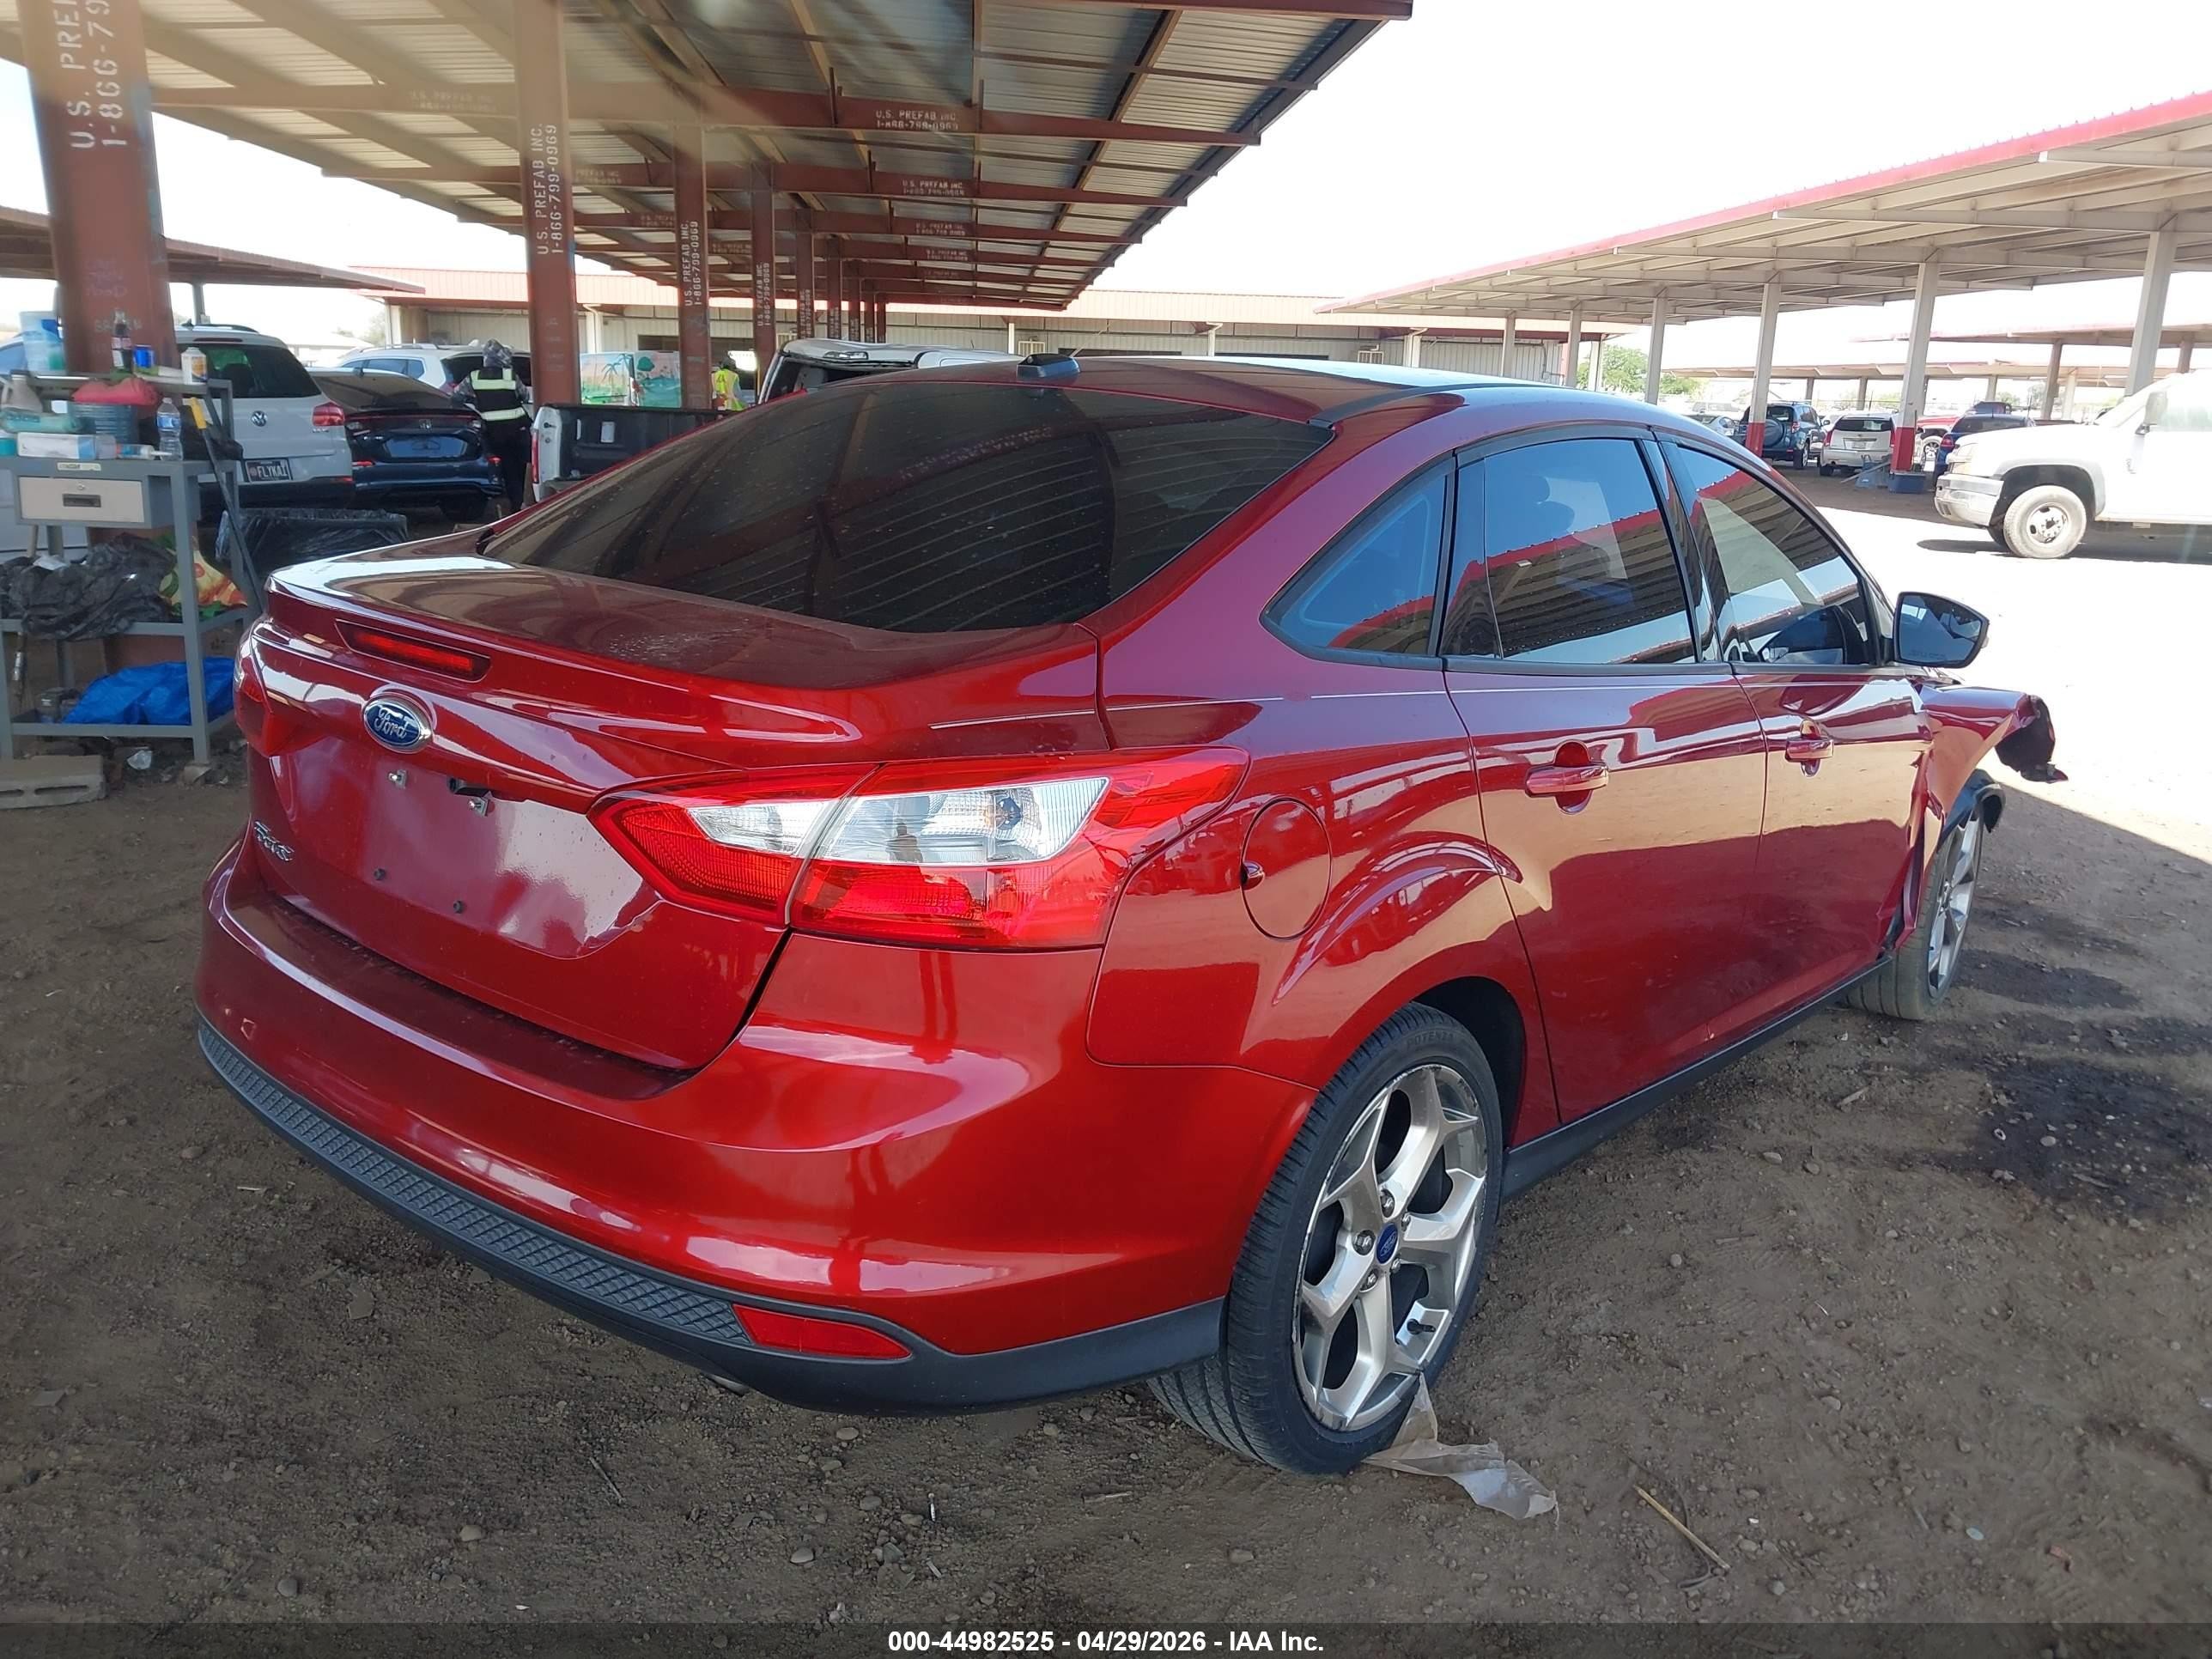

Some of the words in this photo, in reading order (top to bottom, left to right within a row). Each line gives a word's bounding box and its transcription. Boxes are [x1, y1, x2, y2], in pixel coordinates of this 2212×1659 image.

[52, 0, 86, 70] PRE
[66, 91, 95, 149] U.S.
[531, 124, 544, 152] INC.
[532, 160, 547, 218] PREFAB
[545, 125, 564, 253] 1-866-799-0969
[537, 227, 550, 255] U.S.
[681, 244, 692, 283] PREFAB
